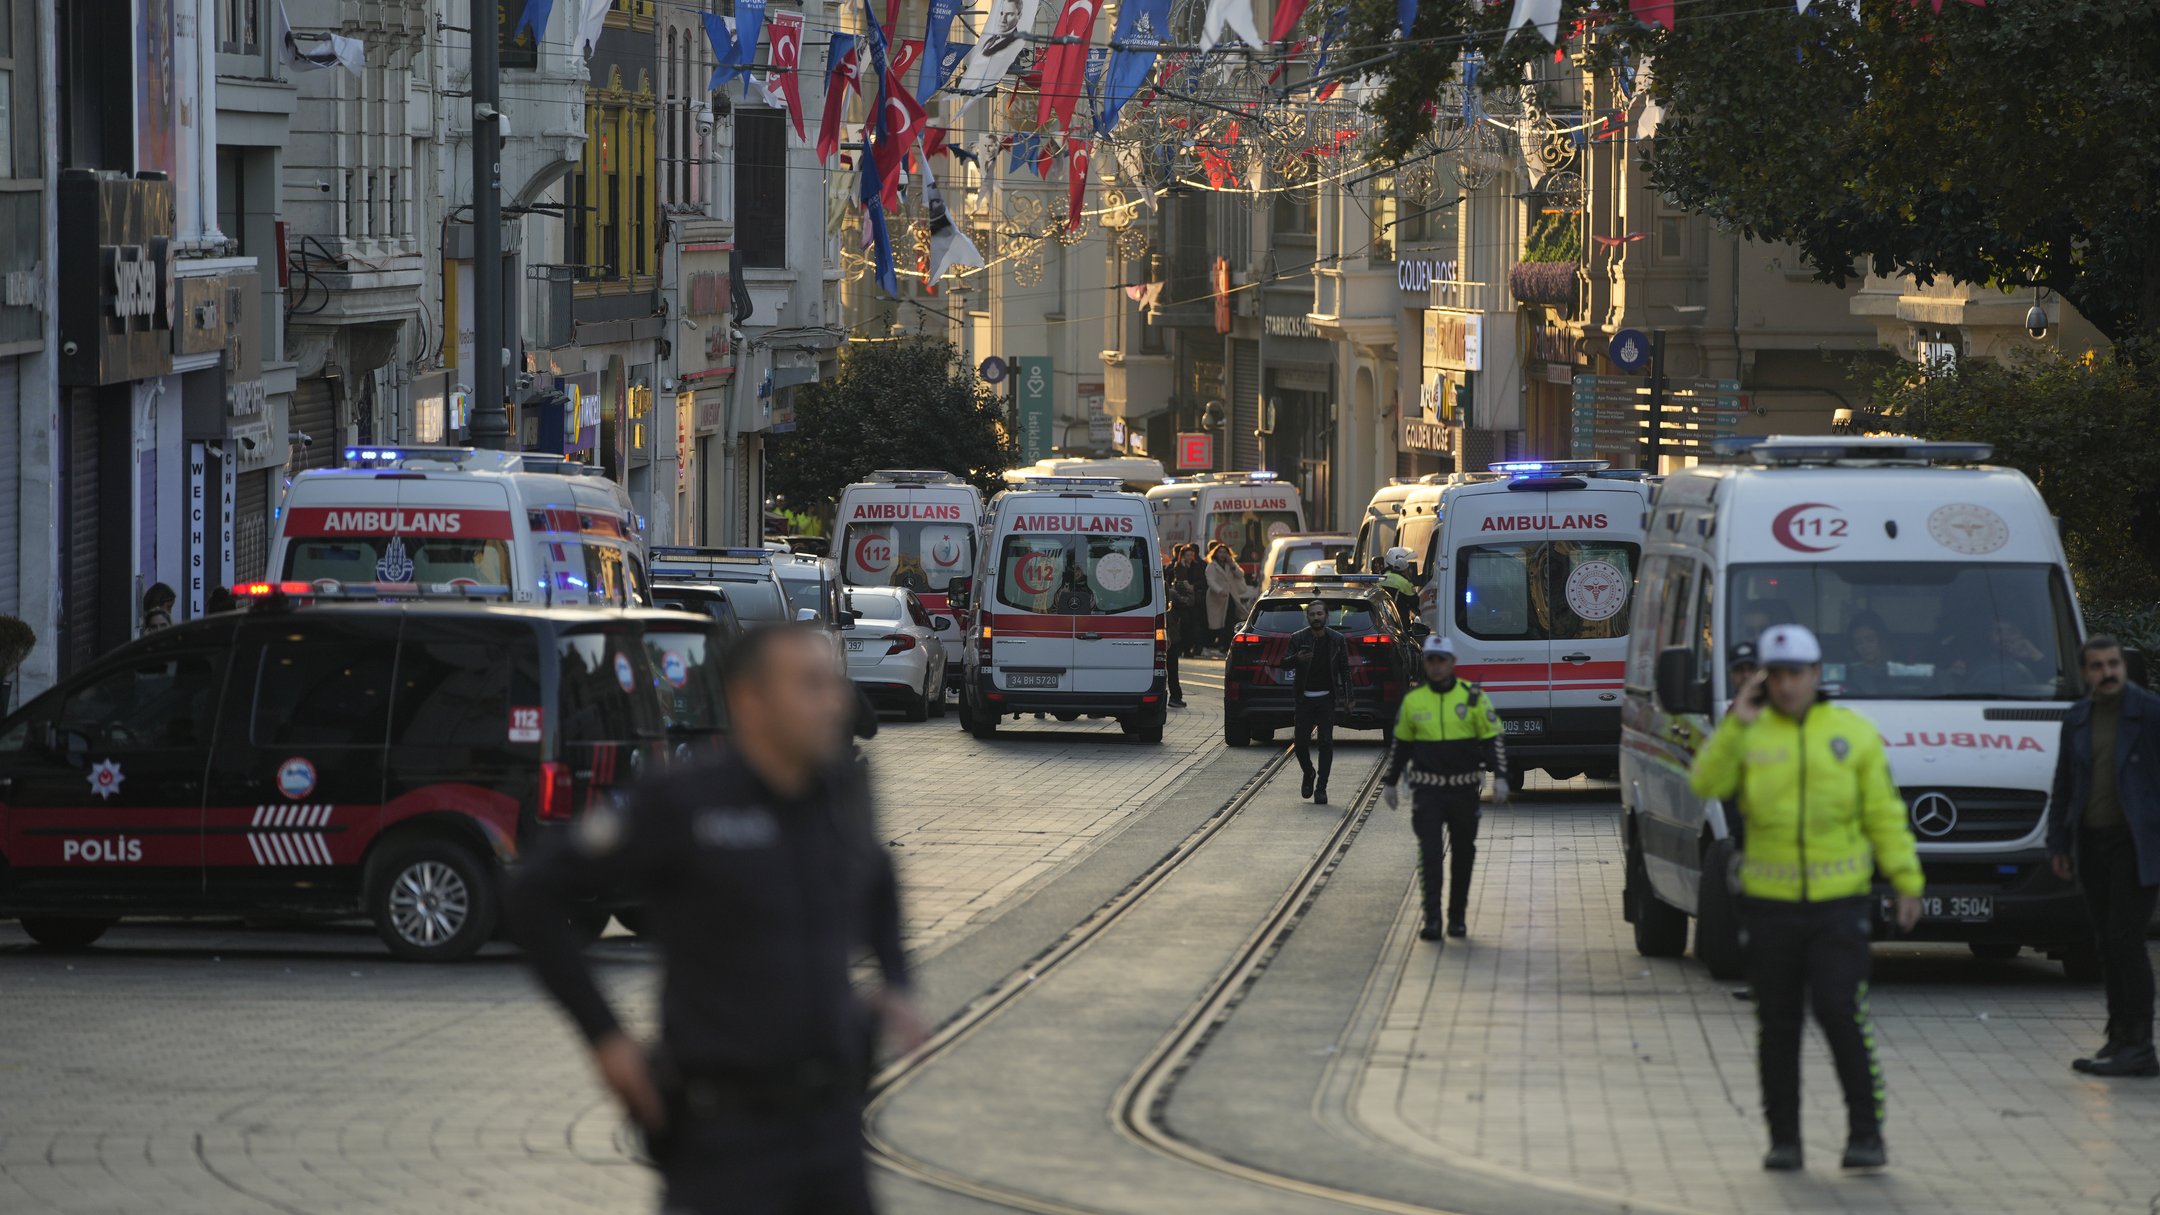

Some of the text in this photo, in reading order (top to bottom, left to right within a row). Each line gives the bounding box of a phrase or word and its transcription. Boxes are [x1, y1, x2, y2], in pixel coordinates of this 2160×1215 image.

[1398, 259, 1457, 292] GOLDEN ROSE
[115, 244, 156, 333] SuperStep
[1265, 315, 1300, 336] STARBUCKS
[1406, 424, 1448, 451] GOLDEN ROSE
[1186, 441, 1204, 462] E
[853, 504, 960, 519] AMBULANS
[1213, 499, 1287, 510] AMBULANS
[323, 511, 461, 532] AMBULANS
[1013, 515, 1133, 533] AMBULANS
[1481, 514, 1608, 531] AMBULANS
[1791, 518, 1848, 537] 112
[192, 464, 203, 612] WECHSEL
[864, 547, 890, 560] 112
[1026, 566, 1053, 581] 112
[848, 641, 861, 649] 397
[1012, 676, 1057, 685] 34 BH 5720
[513, 709, 539, 728] 112
[1524, 720, 1541, 731] 934
[63, 834, 143, 862] POLİS
[1950, 898, 1990, 916] 3504
